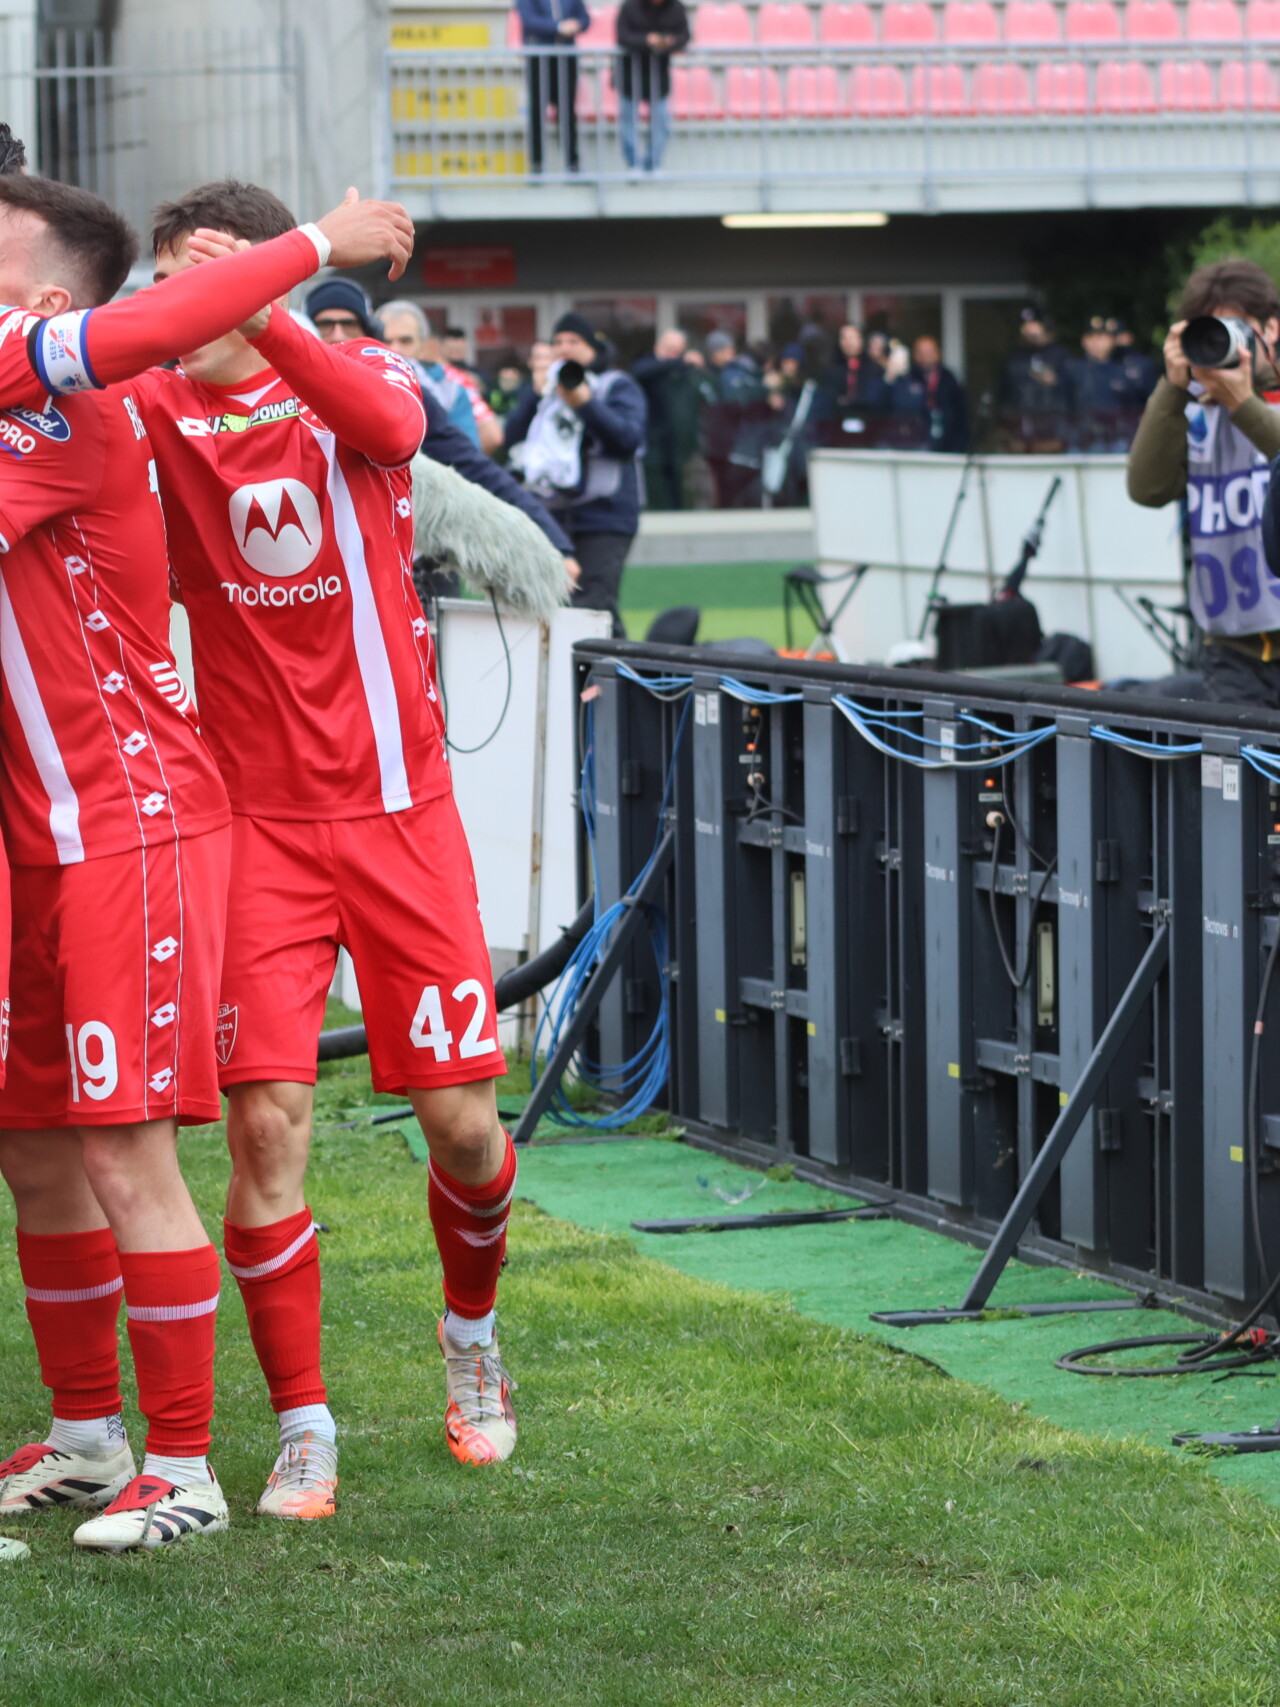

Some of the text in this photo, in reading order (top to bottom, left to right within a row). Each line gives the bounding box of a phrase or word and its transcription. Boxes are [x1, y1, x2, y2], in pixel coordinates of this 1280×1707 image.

[49, 340, 58, 360] KEEP
[221, 576, 342, 607] motorola
[216, 1022, 233, 1032] ONZA
[409, 979, 497, 1062] 42
[65, 1021, 118, 1103] 19
